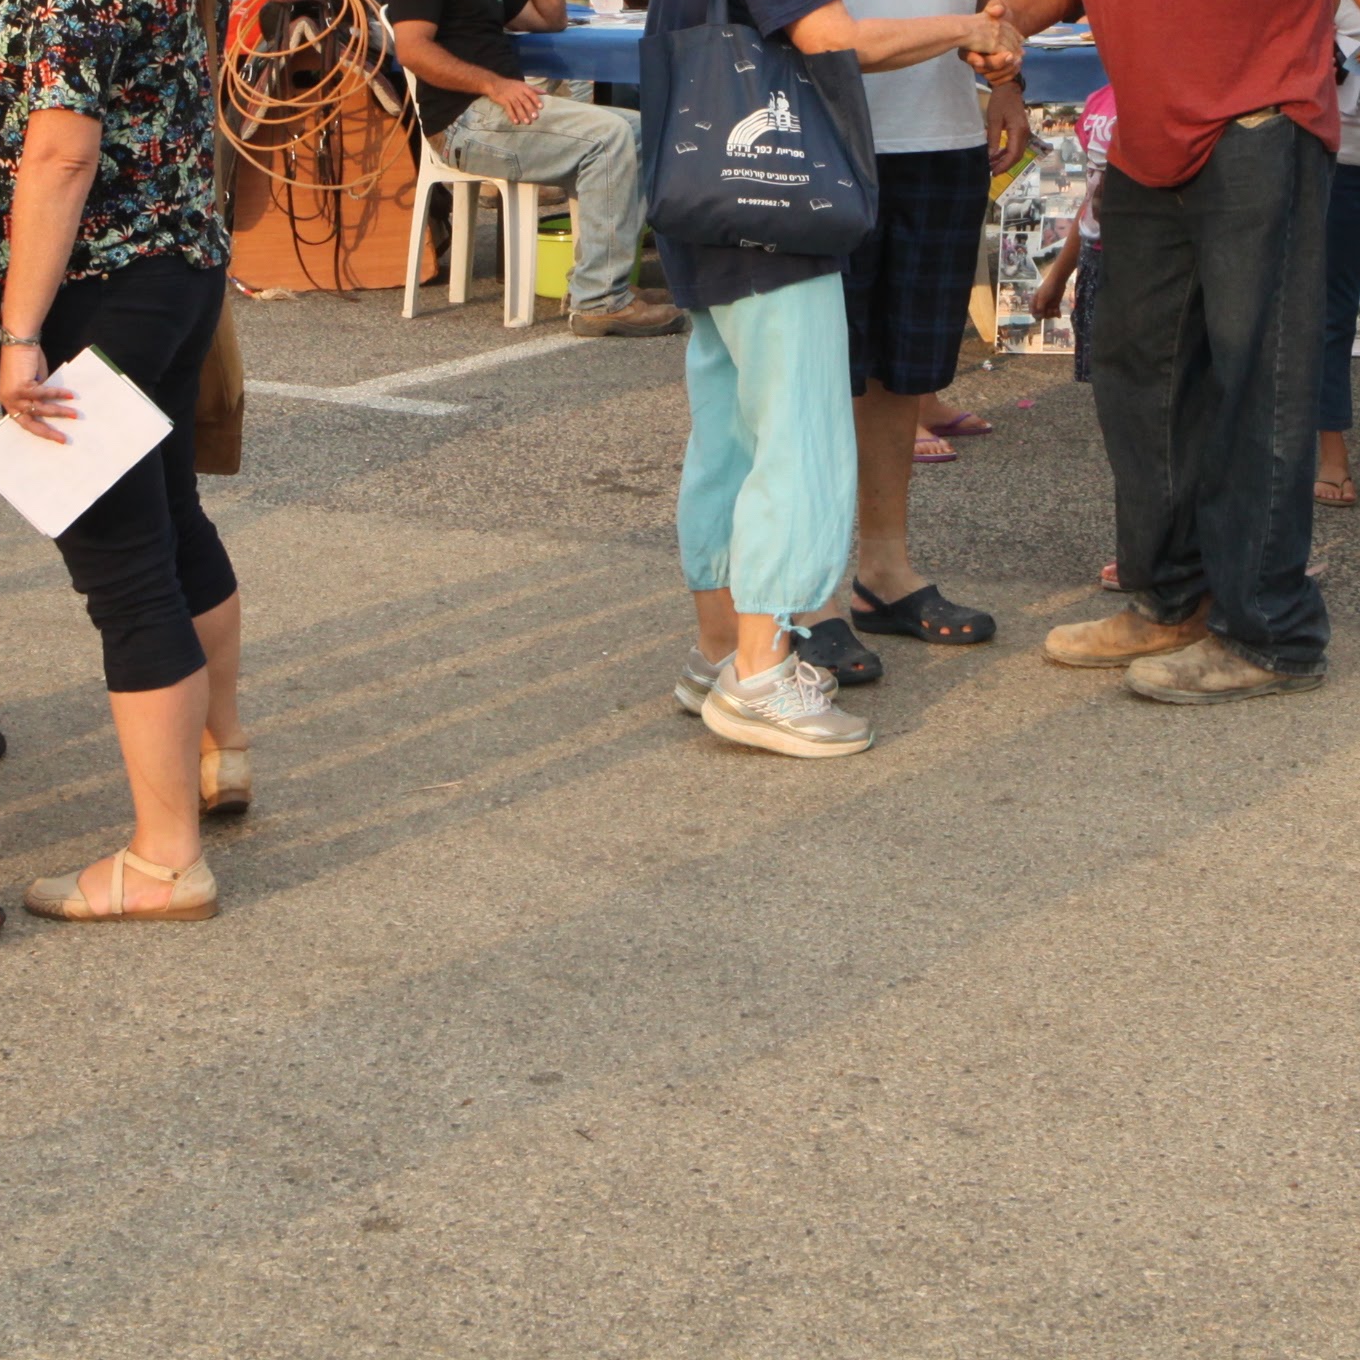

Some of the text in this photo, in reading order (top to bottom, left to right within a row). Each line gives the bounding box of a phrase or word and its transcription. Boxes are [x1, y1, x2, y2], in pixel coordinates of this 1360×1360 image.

[726, 143, 751, 152] ורדים
[754, 145, 773, 154] כפר
[766, 172, 788, 181] טובים
[788, 174, 810, 182] דברים
